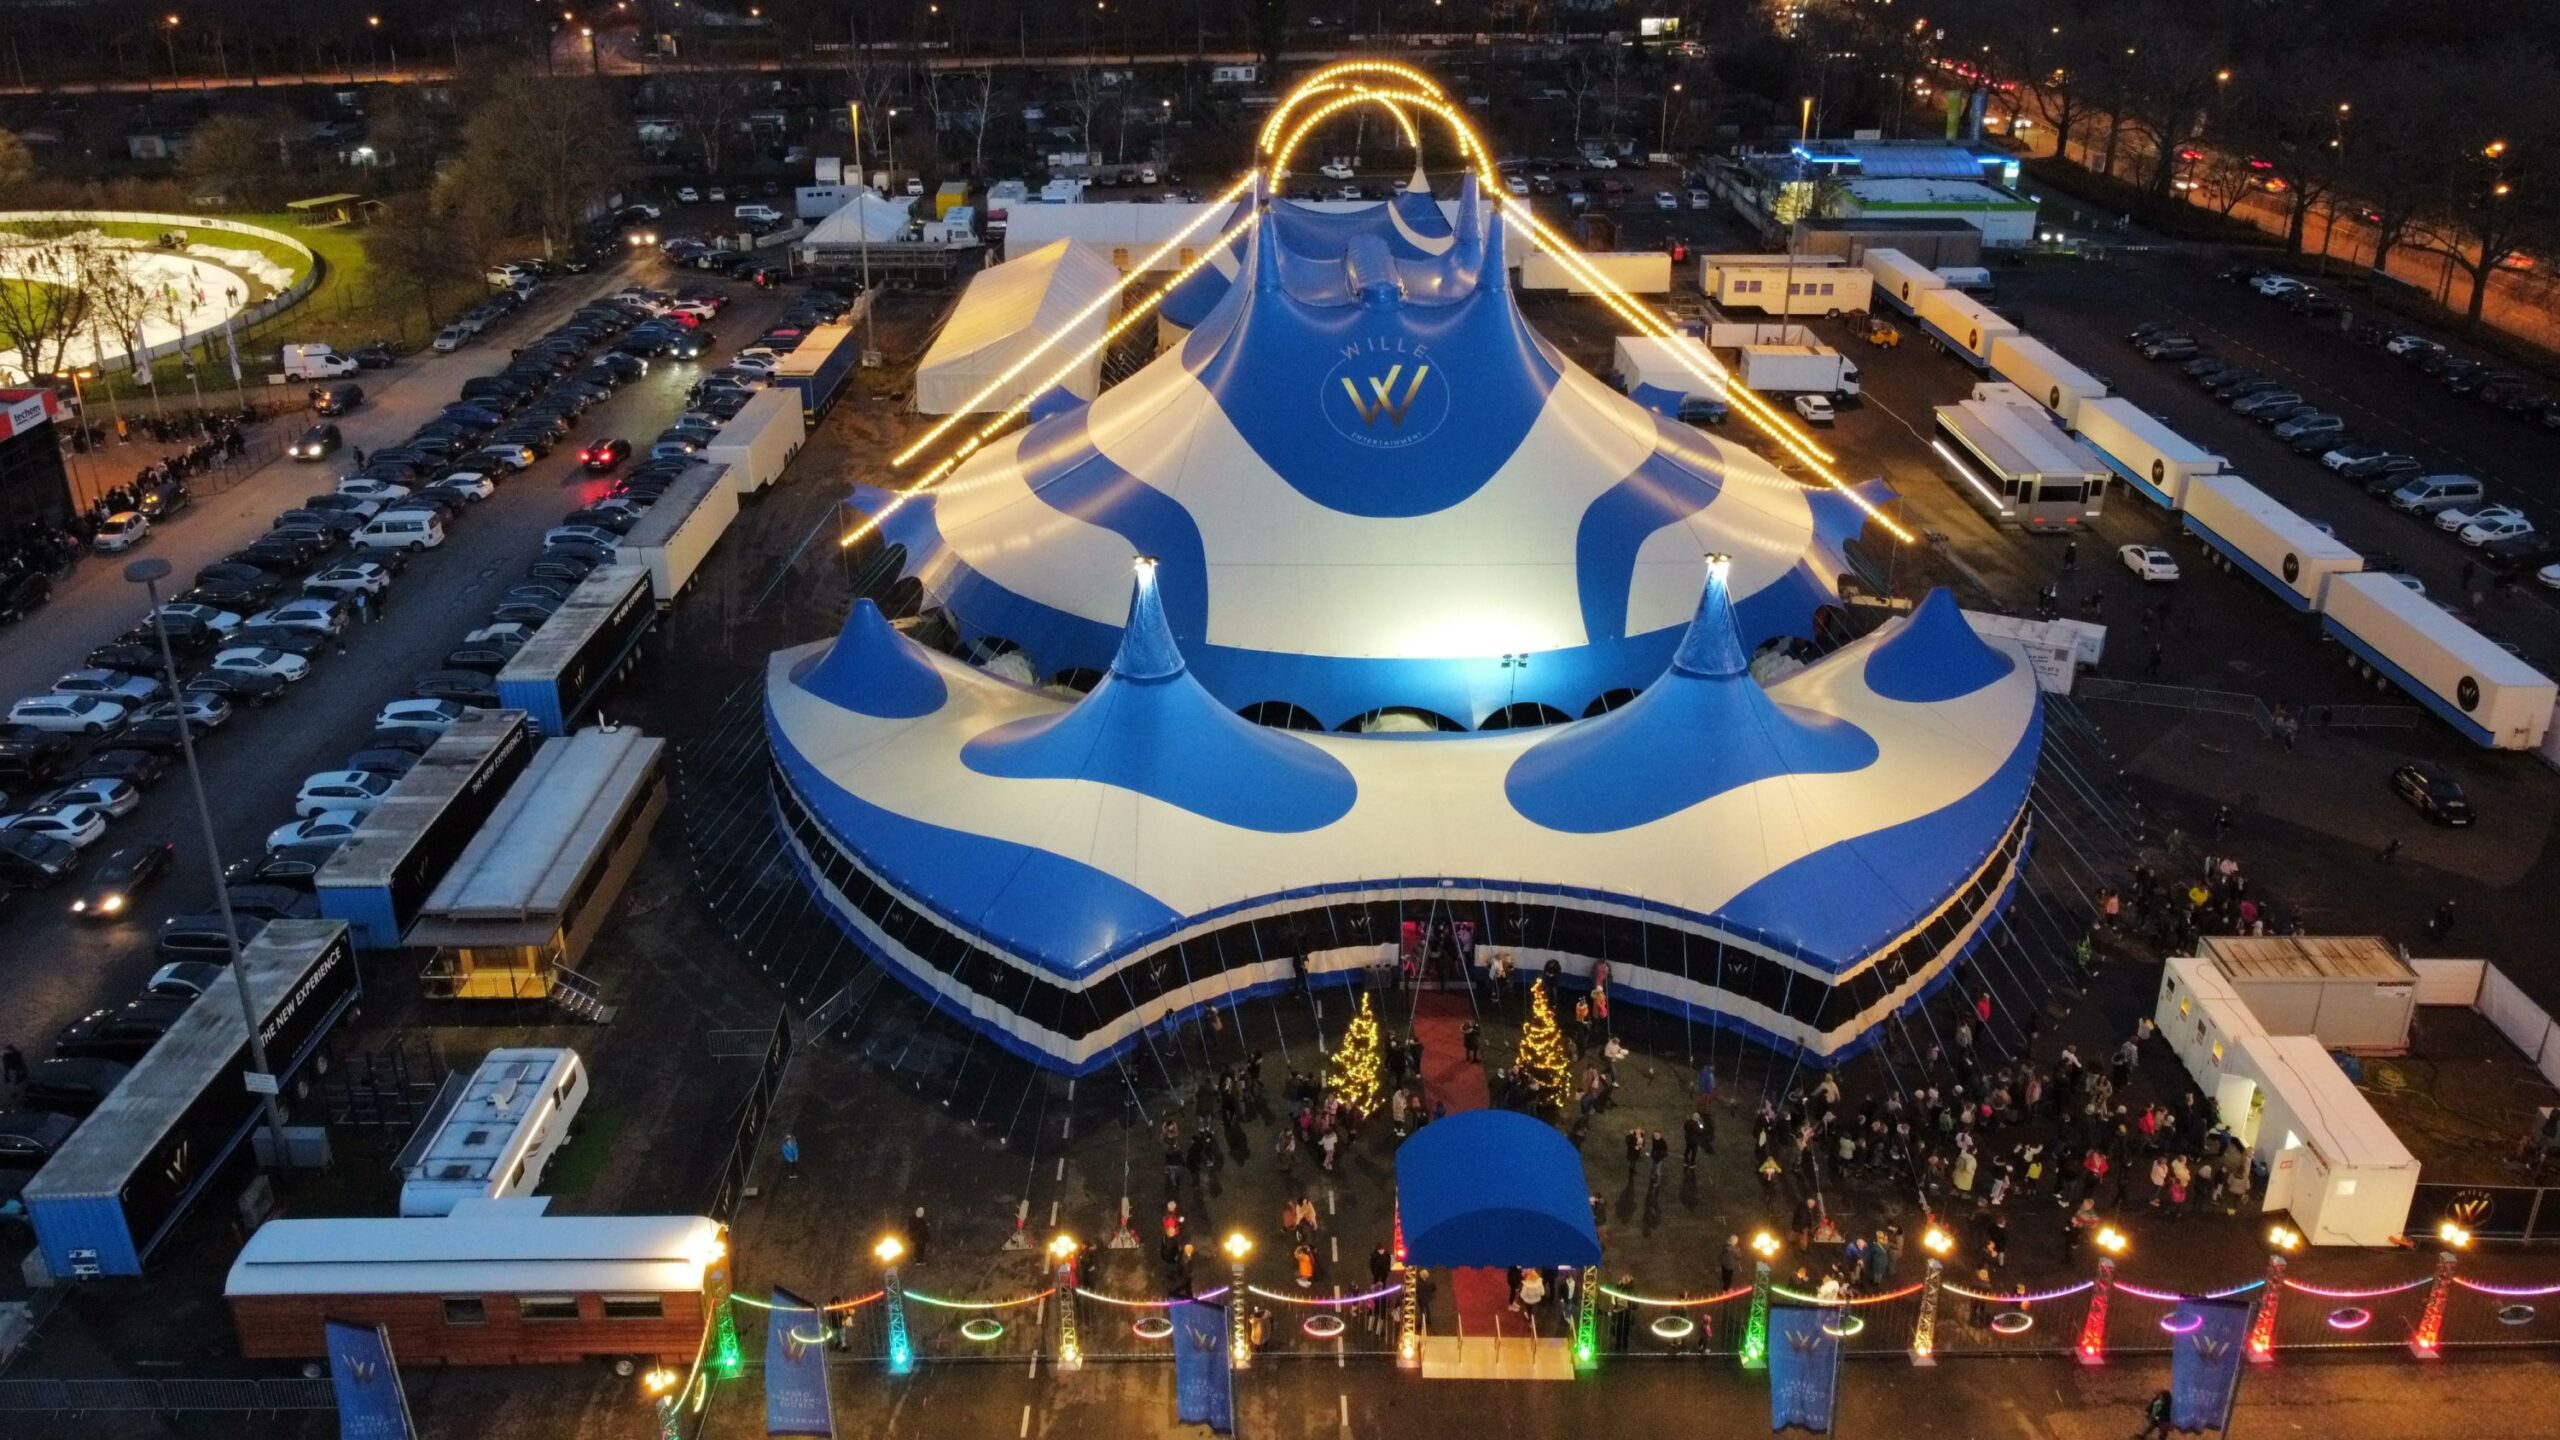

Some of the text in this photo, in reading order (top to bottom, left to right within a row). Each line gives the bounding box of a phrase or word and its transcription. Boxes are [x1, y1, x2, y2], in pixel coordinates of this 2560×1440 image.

[1339, 335, 1429, 361] WILLE
[13, 404, 41, 423] techem
[1351, 431, 1422, 447] ENTERTAINMENT
[472, 728, 523, 795] THE NEW EXPERIENCE
[260, 946, 342, 1048] THE NEW EXPERIENCE
